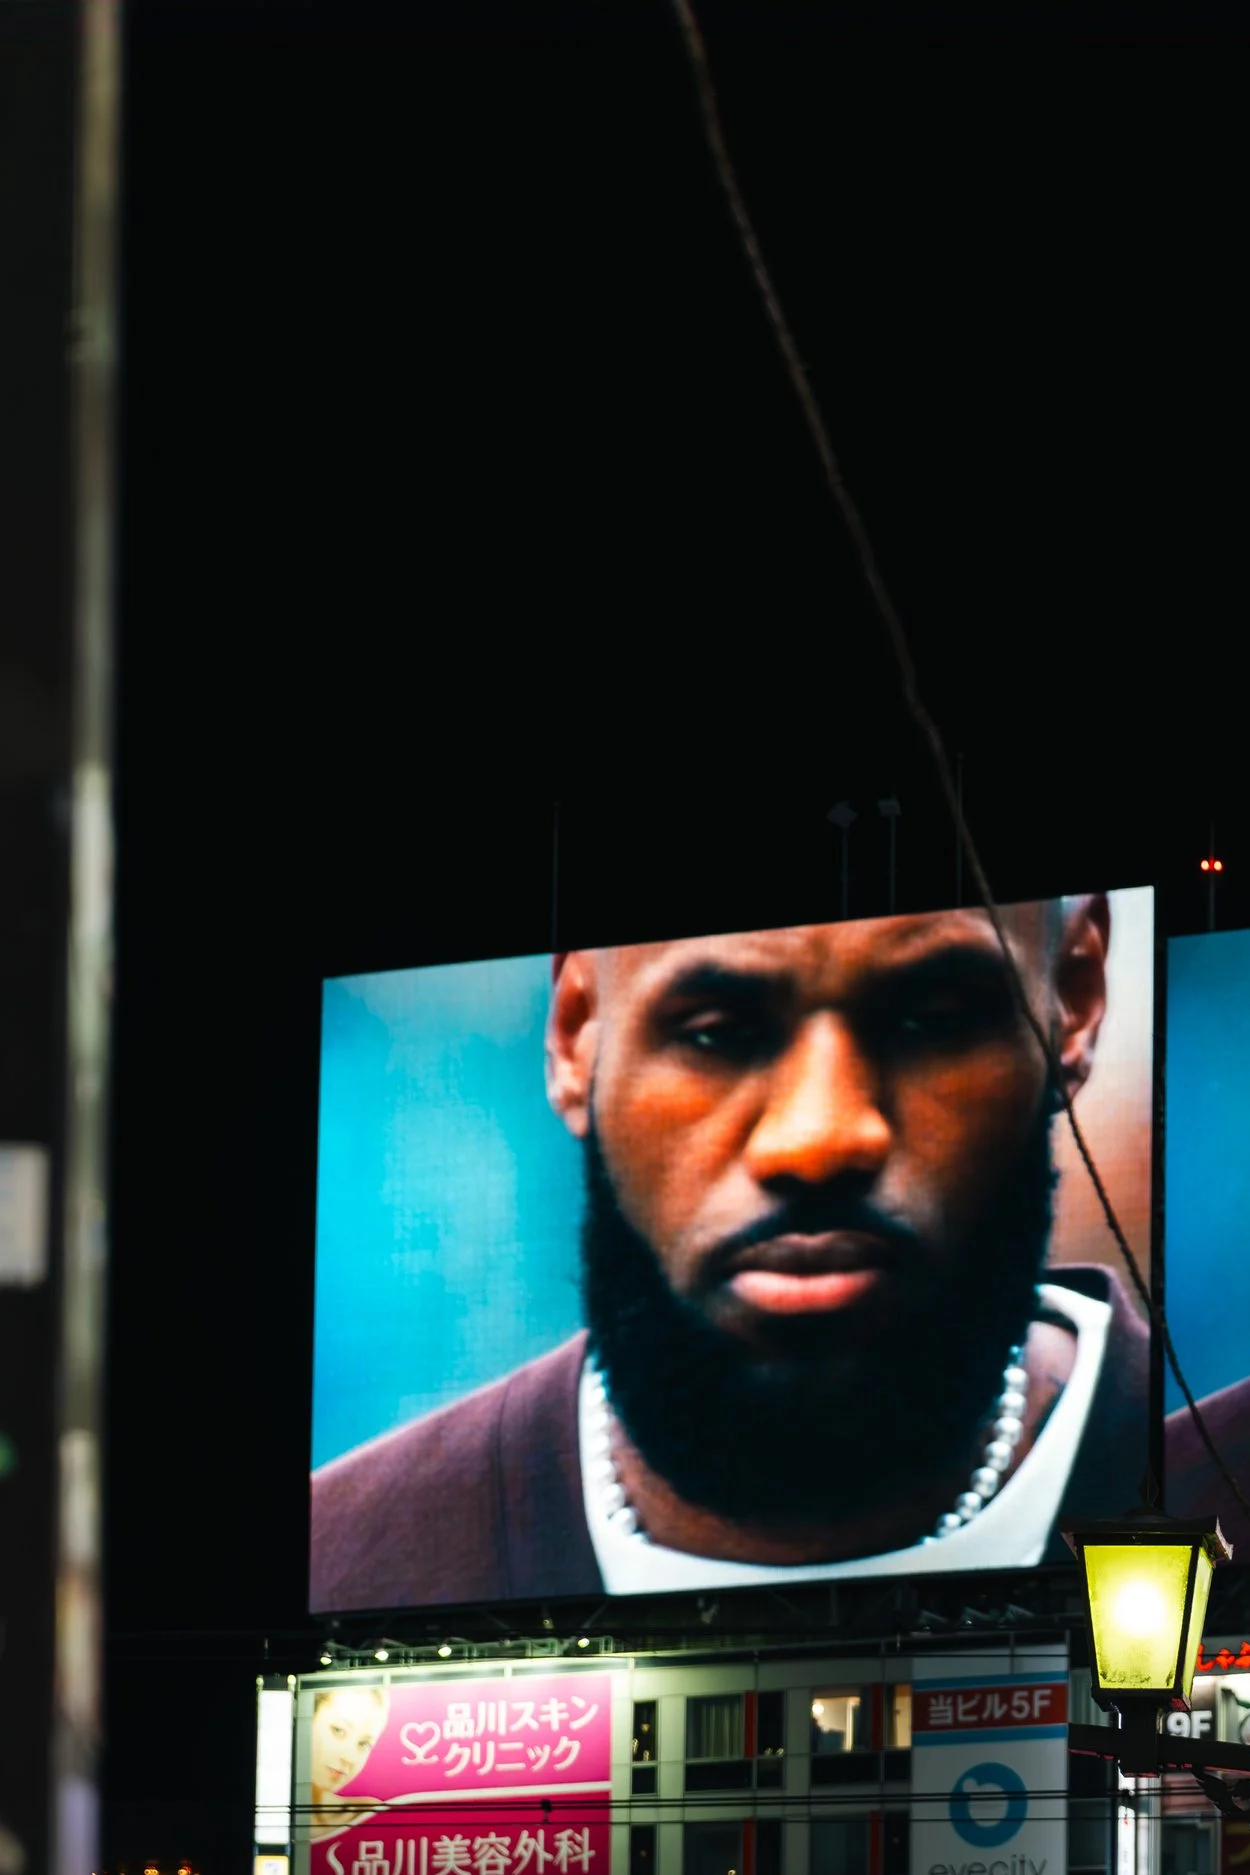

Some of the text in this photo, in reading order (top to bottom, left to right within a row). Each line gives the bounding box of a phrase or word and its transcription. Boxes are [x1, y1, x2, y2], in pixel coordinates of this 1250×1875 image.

[443, 1695, 599, 1740] 品川スキン
[929, 1689, 1052, 1726] 当ビル5F
[1167, 1710, 1212, 1738] 9F
[444, 1737, 581, 1777] クリニック
